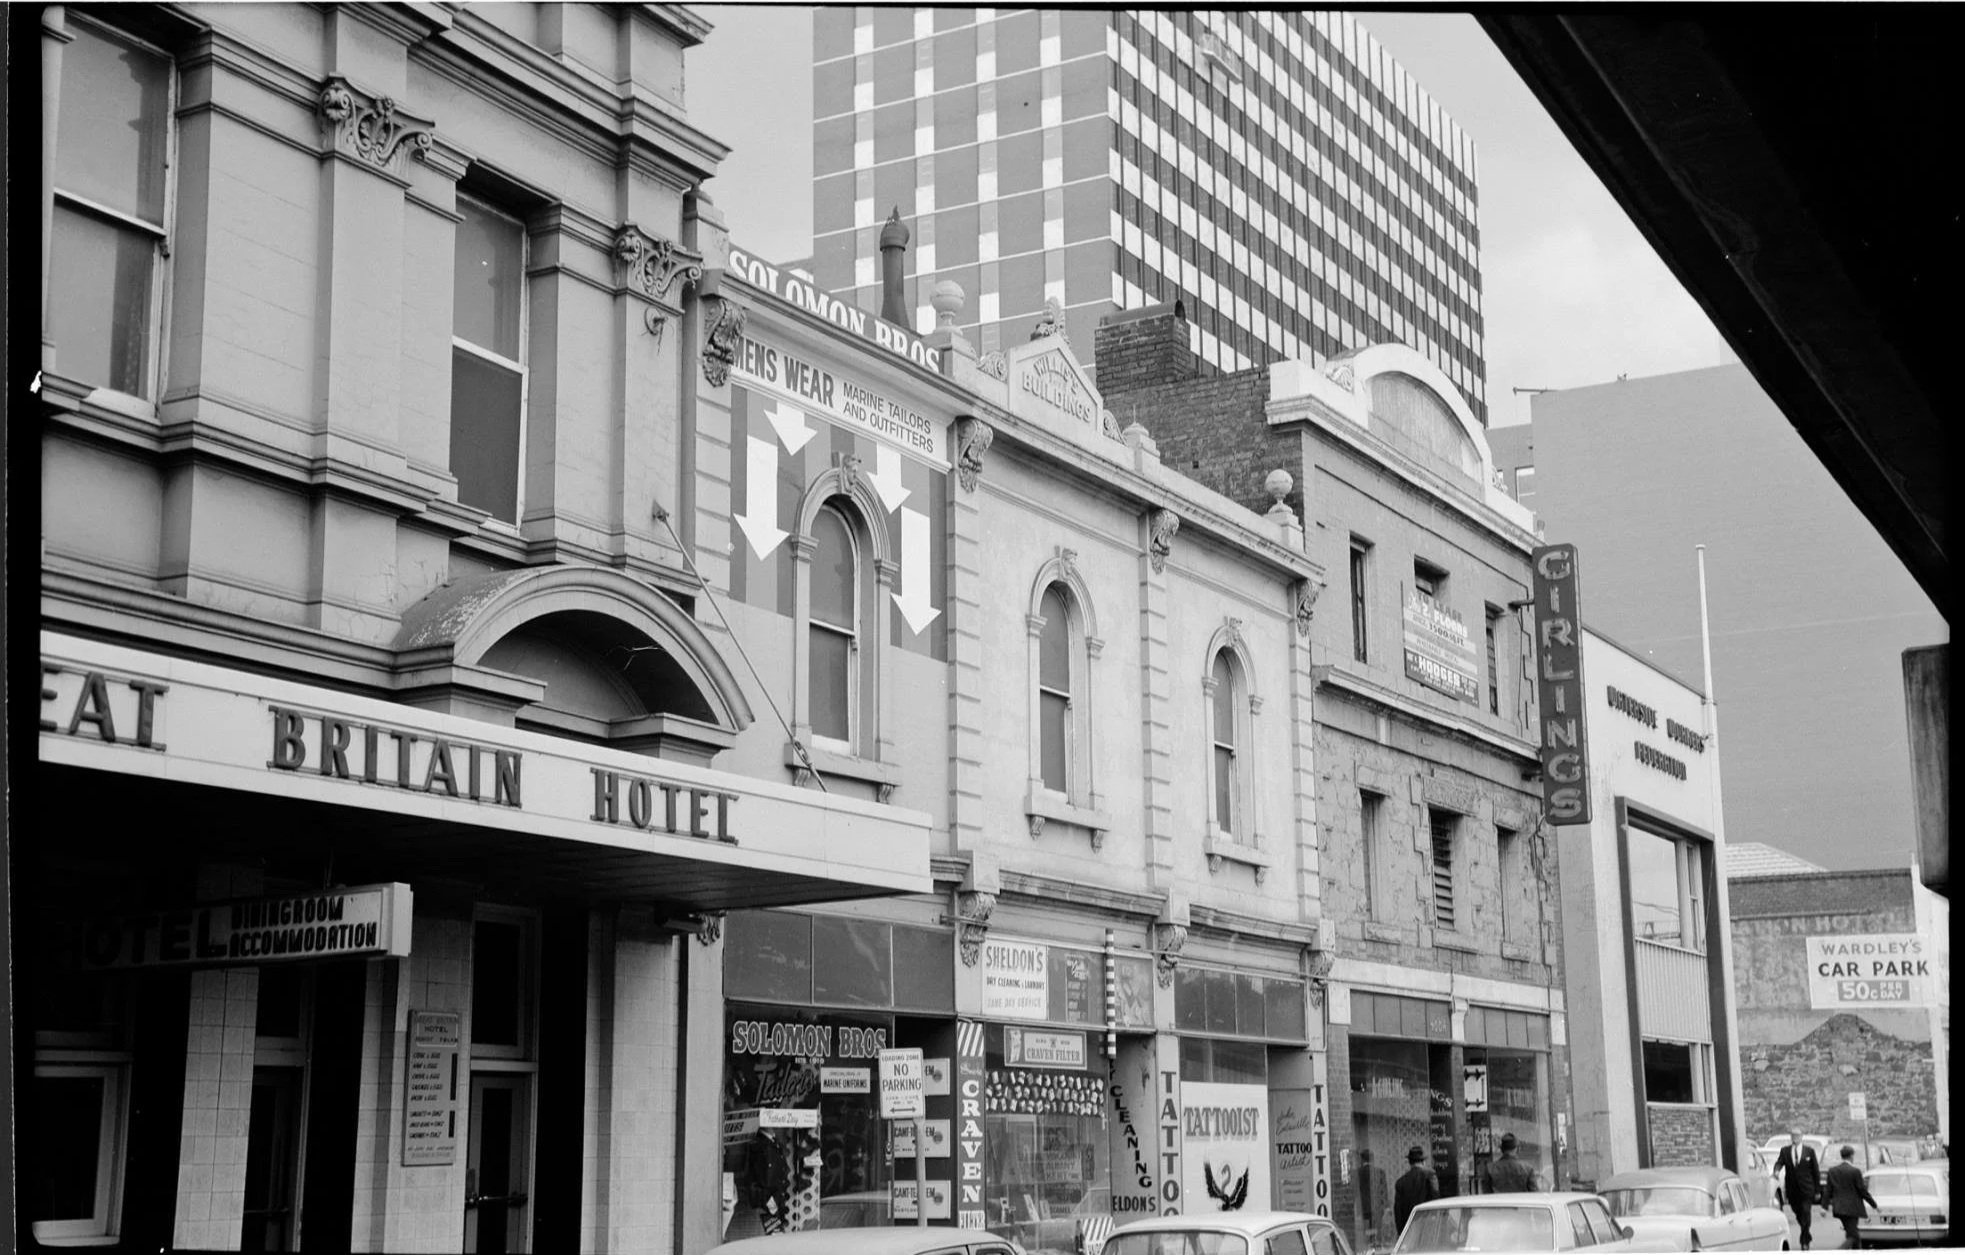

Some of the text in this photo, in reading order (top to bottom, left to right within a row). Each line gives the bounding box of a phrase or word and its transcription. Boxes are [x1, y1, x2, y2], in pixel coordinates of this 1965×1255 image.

[729, 250, 940, 374] SOLOMON BROS
[733, 338, 834, 408] MENS WEAR
[843, 382, 932, 434] MARINE TAILORS
[1023, 371, 1091, 423] BUILDINGS
[843, 402, 934, 454] AND OUTFITTERS
[268, 704, 523, 810] BRITAIN
[590, 766, 740, 846] HOTEL
[228, 922, 378, 958] ACCOMMODATION
[1821, 938, 1923, 956] WARDLEY'S
[986, 946, 1044, 973] SHELDON'S
[1818, 960, 1930, 977] CAR PARK
[1880, 990, 1902, 999] DAY
[732, 1020, 887, 1059] SOLOMON BROS
[1026, 1047, 1080, 1062] CRAVEN FILTER
[823, 1078, 868, 1089] MARINE UNIFORMS
[882, 1078, 922, 1092] PARKING
[893, 1063, 909, 1076] NO
[1110, 1085, 1153, 1188] CLEANING
[1183, 1107, 1261, 1137] TATTOOIST
[960, 1080, 983, 1203] CRAVEN
[1276, 1142, 1313, 1155] TATTOO
